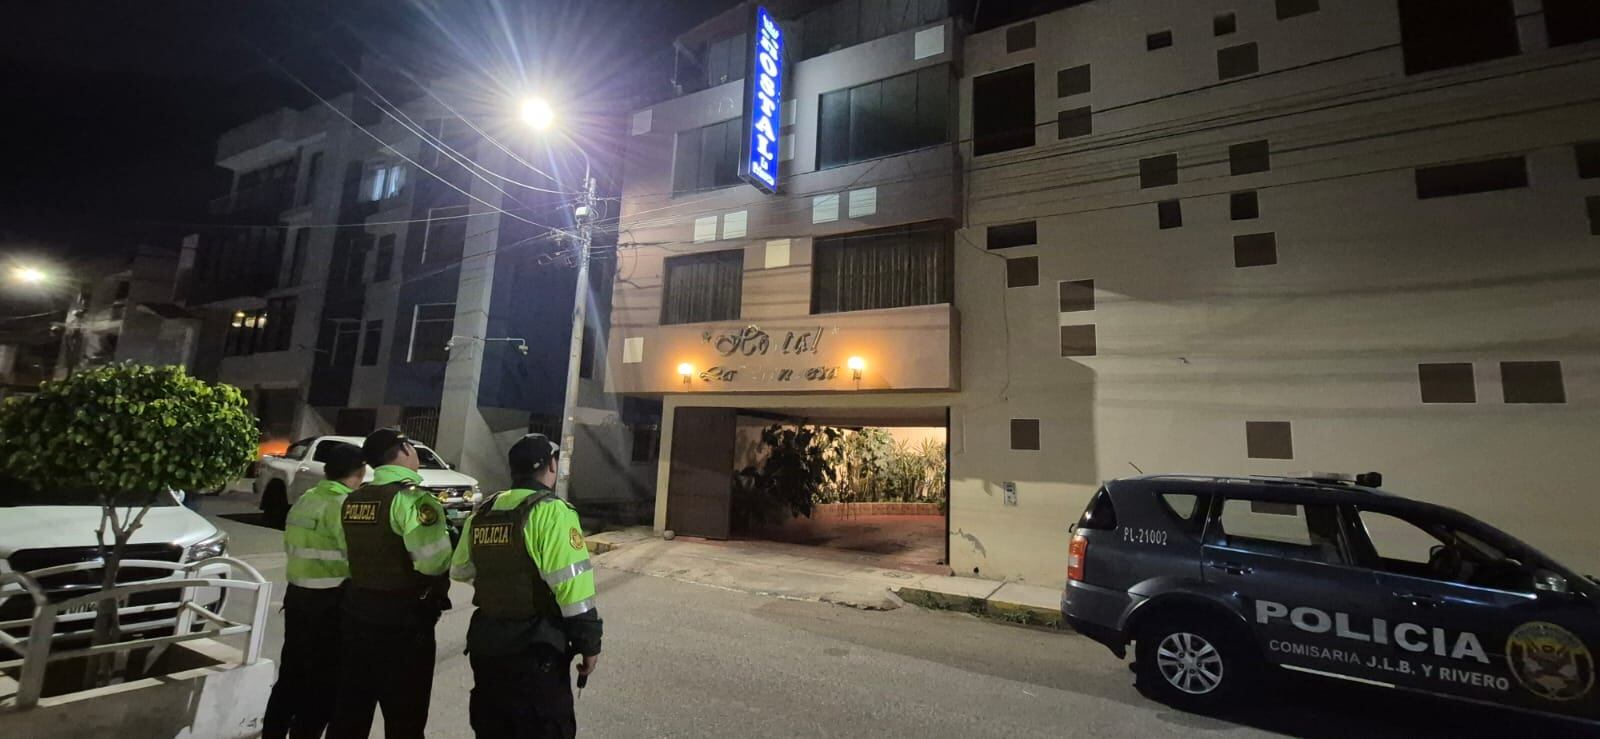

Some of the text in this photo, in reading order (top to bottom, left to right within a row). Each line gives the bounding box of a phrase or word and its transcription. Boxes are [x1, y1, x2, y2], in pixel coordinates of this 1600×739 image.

[754, 28, 780, 161] HOSTAL
[714, 325, 824, 357] Hotal
[344, 504, 376, 520] POLICIA
[473, 526, 509, 545] POLICIA
[1123, 527, 1168, 545] PL-21002
[1255, 599, 1490, 664] POLICIA
[1269, 639, 1509, 691] COMISARIA J.L.B. Y RIVERO
